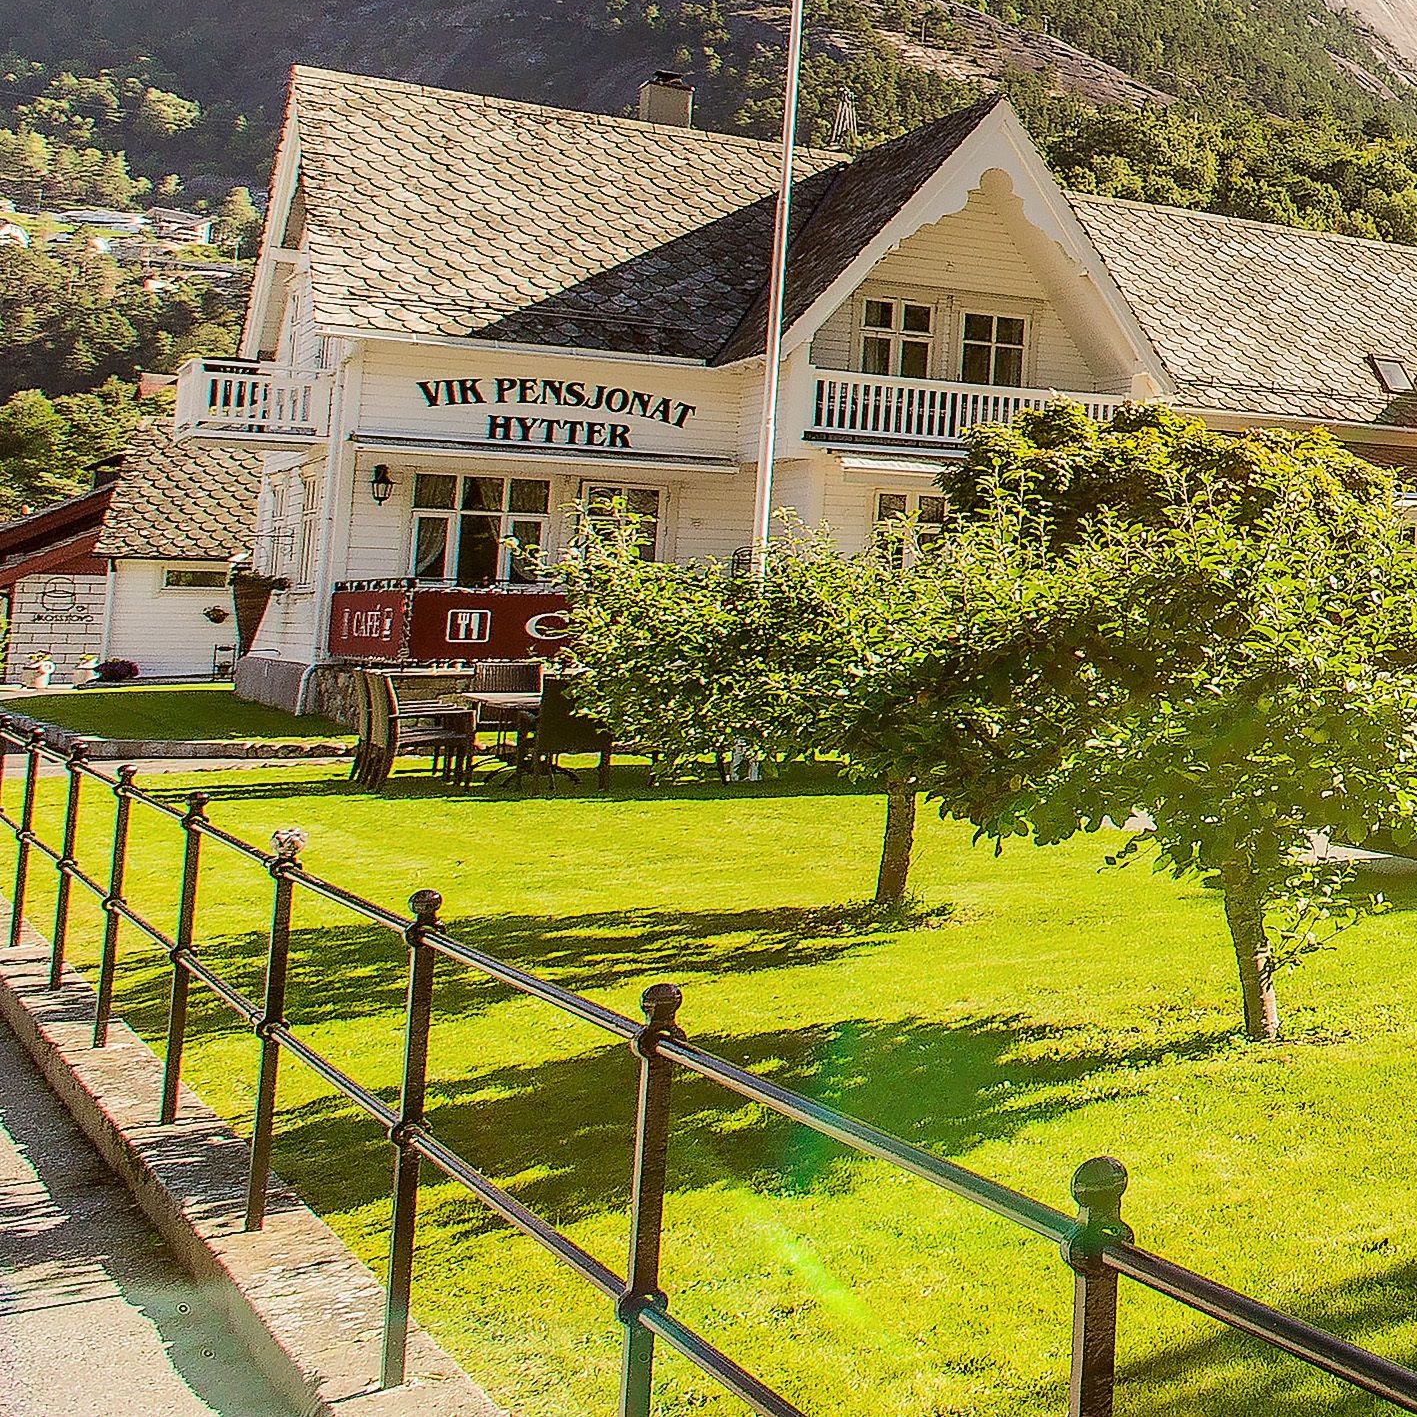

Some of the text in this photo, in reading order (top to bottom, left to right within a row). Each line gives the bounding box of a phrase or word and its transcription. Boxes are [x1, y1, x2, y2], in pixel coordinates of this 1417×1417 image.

[416, 377, 697, 429] VIK PENSJONAT
[486, 414, 633, 448] HYTTER
[353, 604, 381, 637] CAFÉ
